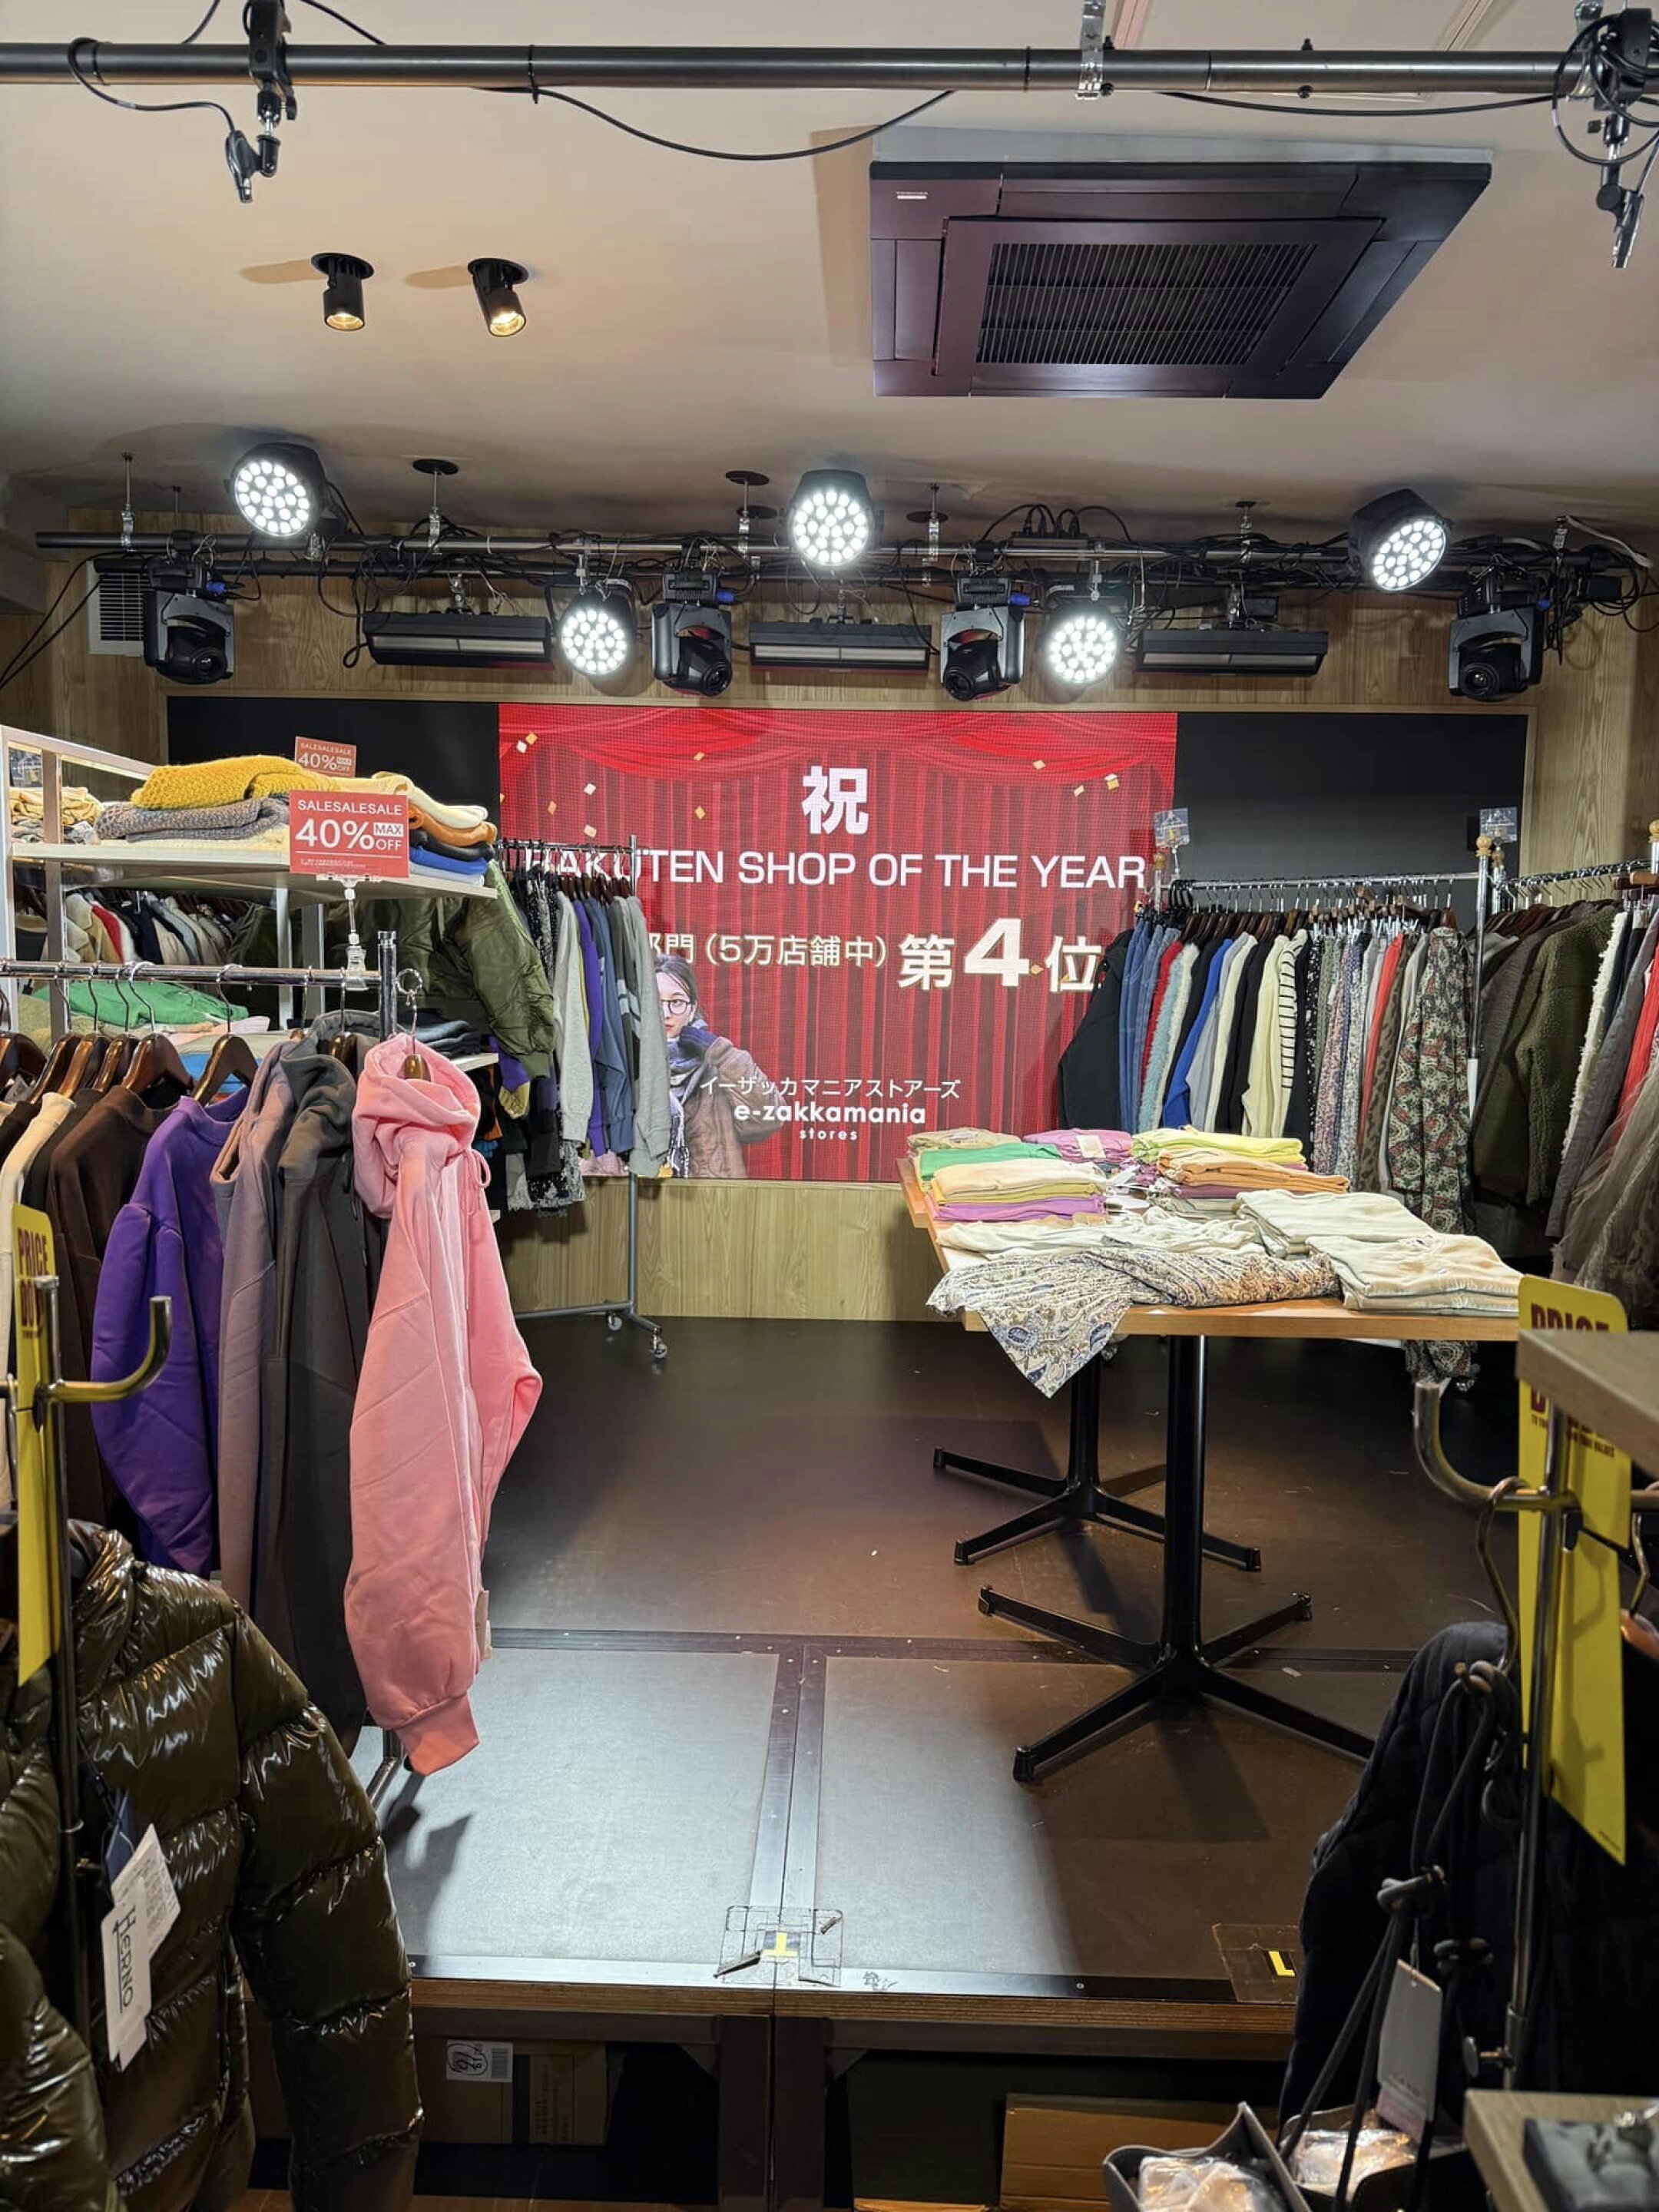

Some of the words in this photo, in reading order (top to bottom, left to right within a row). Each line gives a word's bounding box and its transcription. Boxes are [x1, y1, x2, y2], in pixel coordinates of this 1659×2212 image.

[298, 751, 337, 771] 40%
[297, 800, 402, 816] SALESALESALE
[801, 765, 869, 835] 祝
[295, 817, 375, 850] 40%
[375, 823, 402, 836] MAX
[376, 839, 402, 851] OFF
[738, 850, 856, 886] SHOP
[869, 853, 923, 886] OF
[935, 854, 1018, 887] THE
[1031, 855, 1145, 889] YEAR
[699, 1076, 961, 1099] イーザッカマニアストアーズ
[733, 1101, 926, 1124] e-zakkamania
[800, 1128, 858, 1141] stores
[18, 1227, 48, 1277] PRICE
